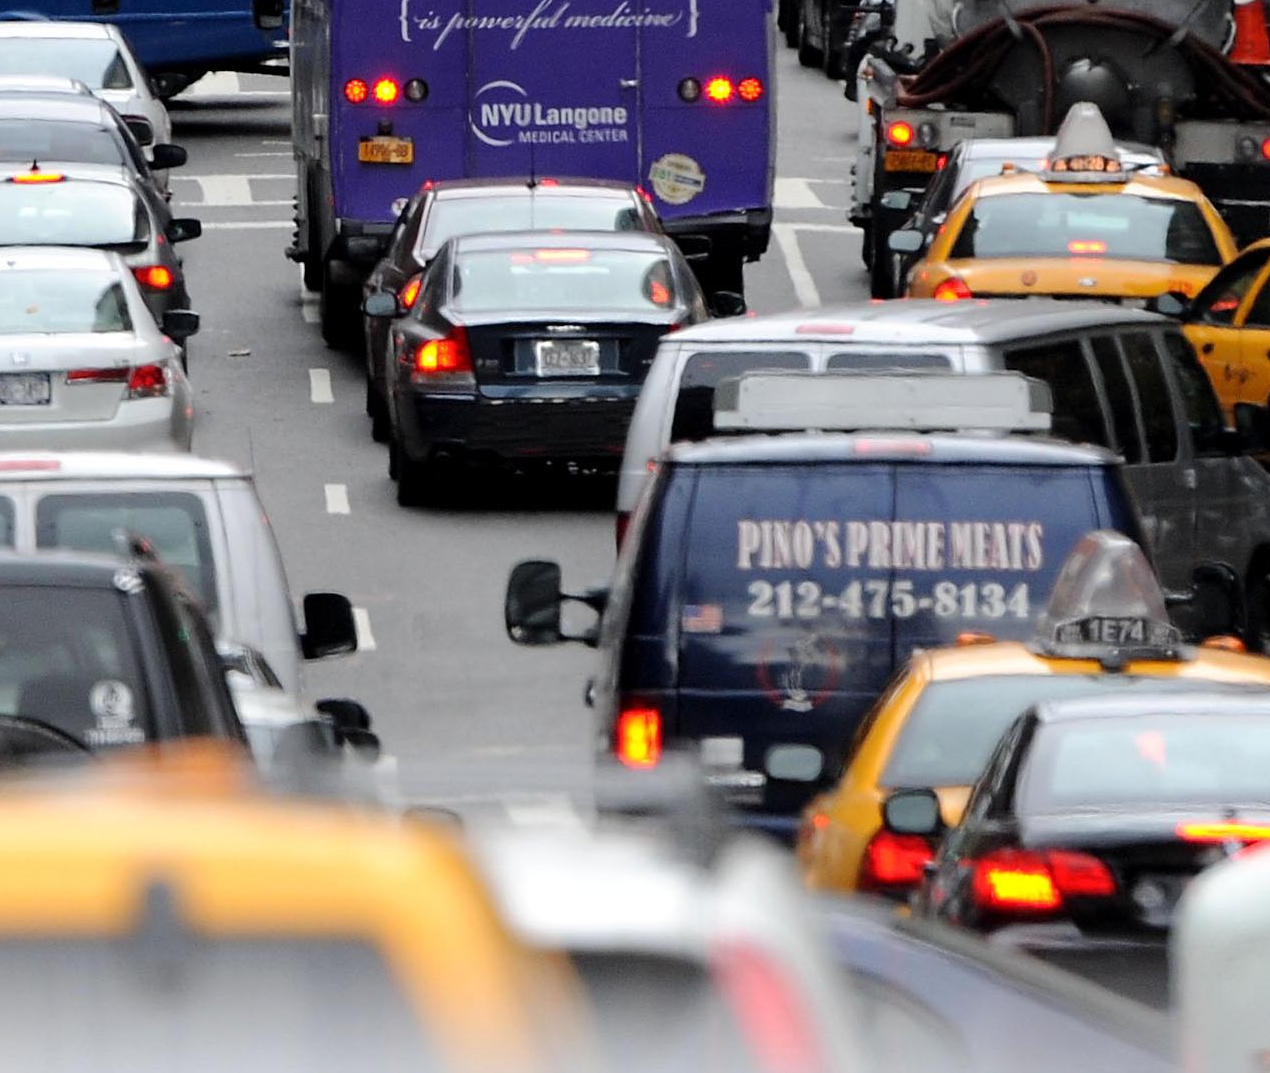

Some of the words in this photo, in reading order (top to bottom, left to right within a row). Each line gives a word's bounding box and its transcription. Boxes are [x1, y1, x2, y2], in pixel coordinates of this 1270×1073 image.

[481, 103, 531, 126] NYU
[534, 104, 629, 129] Langone
[518, 130, 576, 143] MEDICAL
[579, 129, 629, 143] CENTER
[737, 521, 842, 570] PINO'S
[846, 521, 946, 571] PRIME
[951, 521, 1044, 571] MEATS
[747, 579, 1031, 620] 212-475-8134
[1089, 617, 1144, 643] 1E74
